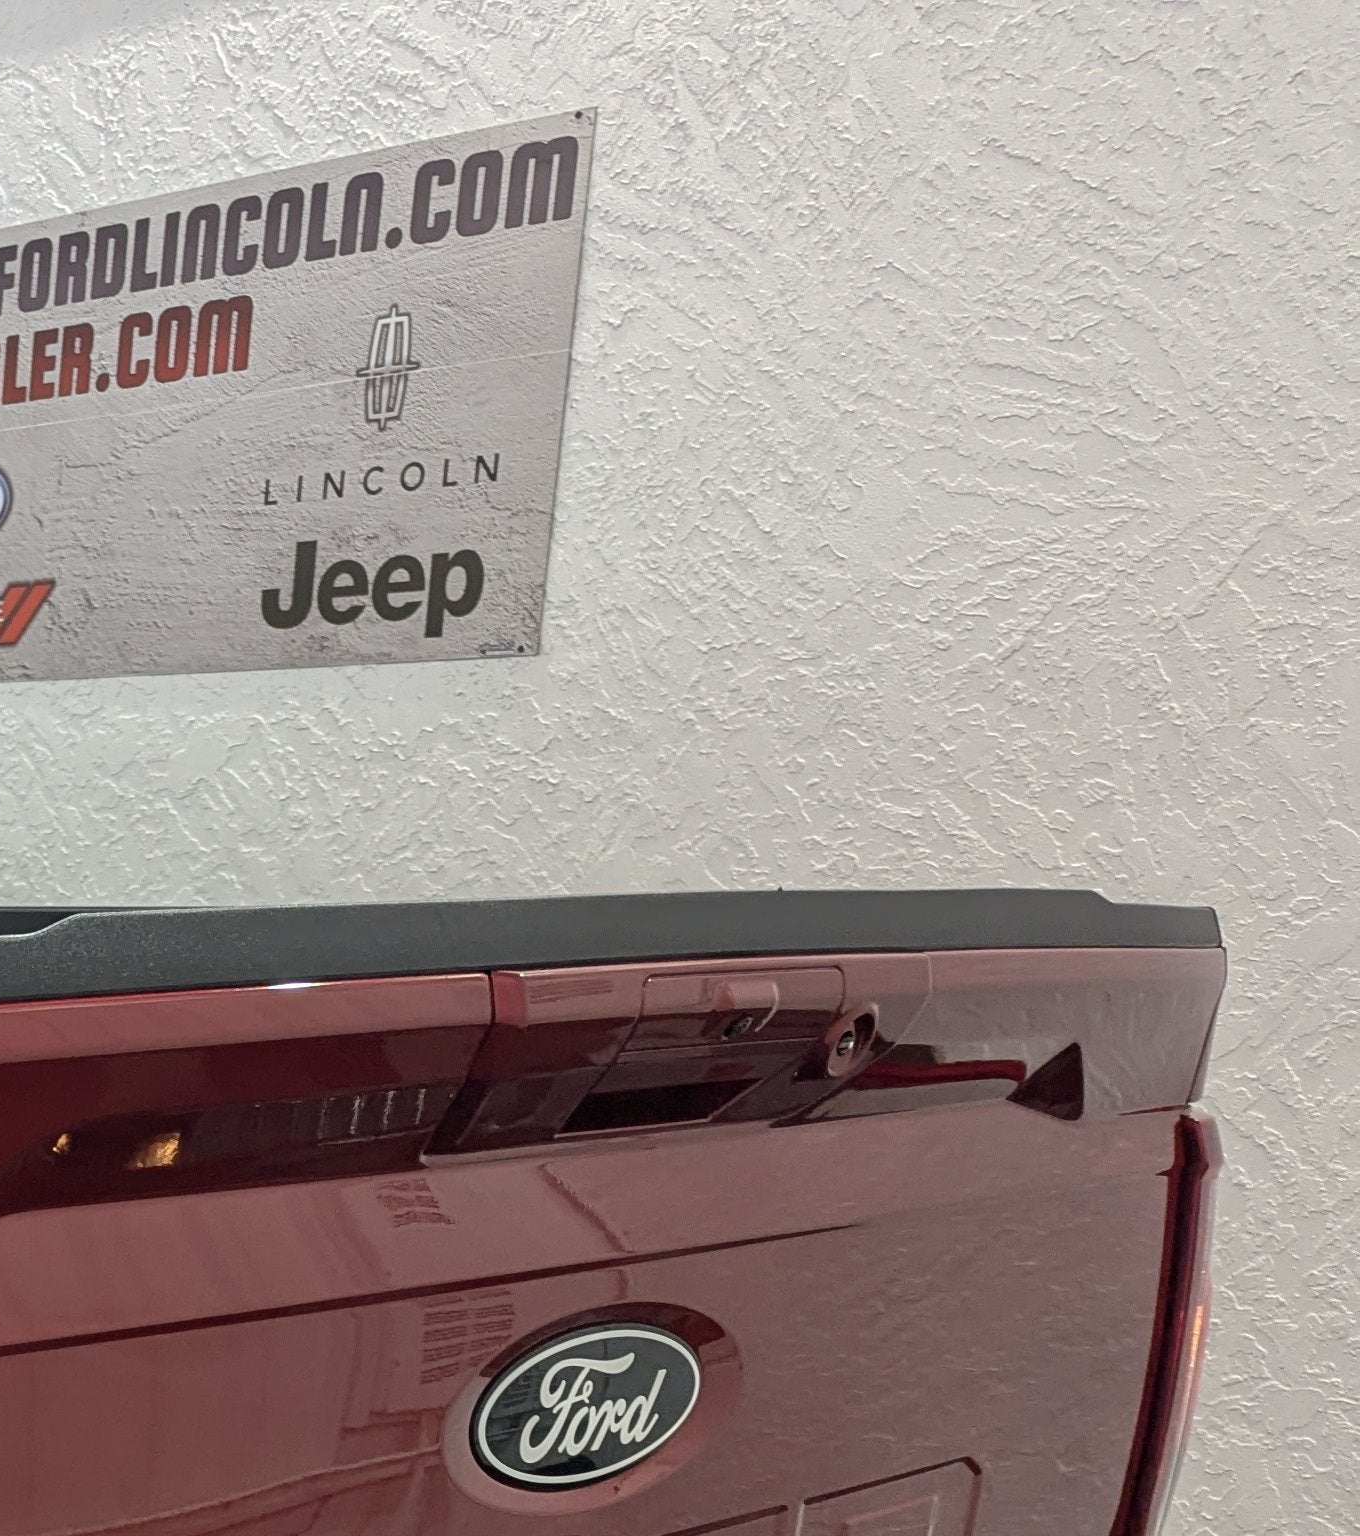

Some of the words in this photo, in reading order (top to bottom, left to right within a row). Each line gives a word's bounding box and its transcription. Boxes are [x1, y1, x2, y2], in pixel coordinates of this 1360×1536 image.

[263, 453, 500, 505] LINCOLN
[261, 540, 484, 638] Jeep
[517, 1350, 660, 1464] Ford
